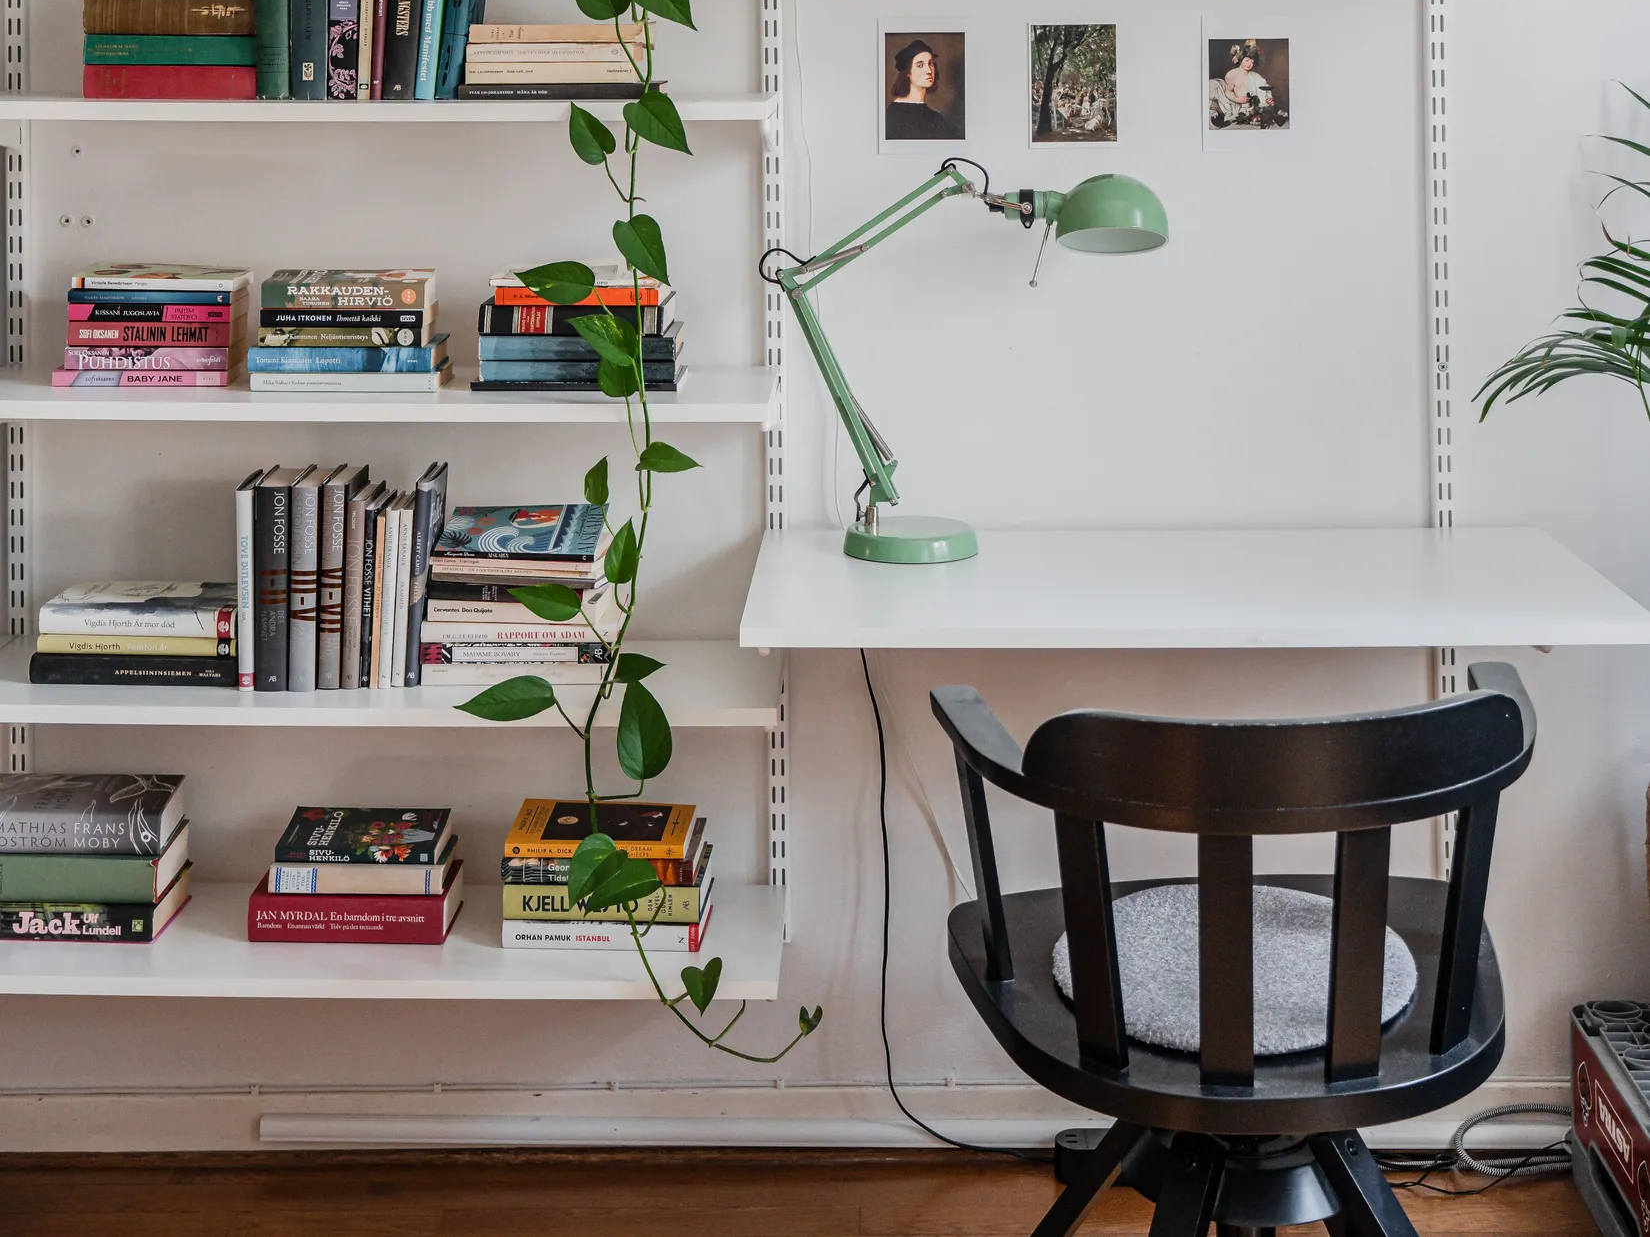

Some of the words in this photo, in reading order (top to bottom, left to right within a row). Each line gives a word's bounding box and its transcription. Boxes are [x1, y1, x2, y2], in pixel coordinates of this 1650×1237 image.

[424, 12, 434, 33] med
[419, 34, 433, 82] Manifestet
[287, 286, 389, 296] RAKKAUDEN-
[337, 295, 393, 306] HIRVIÖ
[122, 309, 160, 317] JUGOSLAVIA
[79, 329, 92, 339] SOFI
[92, 329, 119, 339] OKSANEN
[123, 326, 166, 342] STALININ
[171, 326, 209, 343] LEHMÄT
[78, 355, 171, 370] PUHDISTUS
[127, 375, 156, 383] BABY
[157, 375, 183, 383] JANE
[273, 491, 285, 517] JON
[273, 518, 285, 554] FOSSE
[240, 535, 249, 562] TOVE
[365, 538, 373, 557] JON
[364, 558, 373, 585] FOSSE
[240, 562, 249, 609] DITLEVSEN
[363, 587, 371, 617] VITHET
[84, 619, 107, 628] Vigdis
[108, 619, 132, 629] Hjorth
[134, 618, 144, 628] Är
[161, 621, 175, 629] död
[497, 631, 539, 640] RAPPORT
[542, 631, 557, 639] OM
[560, 631, 585, 639] ADAM
[115, 669, 192, 677] APPELSIININSIEMEN
[74, 822, 125, 834] FRANS
[73, 837, 121, 848] MOBY
[12, 911, 81, 935] Jack
[83, 914, 100, 923] Ulf
[255, 910, 277, 921] JAN
[280, 911, 328, 921] MYRDAL
[330, 912, 342, 921] En
[344, 912, 380, 922] barndom
[398, 915, 425, 923] avsnitt
[82, 925, 122, 936] Lundell
[545, 934, 571, 942] PAMUK
[575, 934, 610, 942] ISTANBUL
[1597, 1096, 1630, 1163] ASTRA
